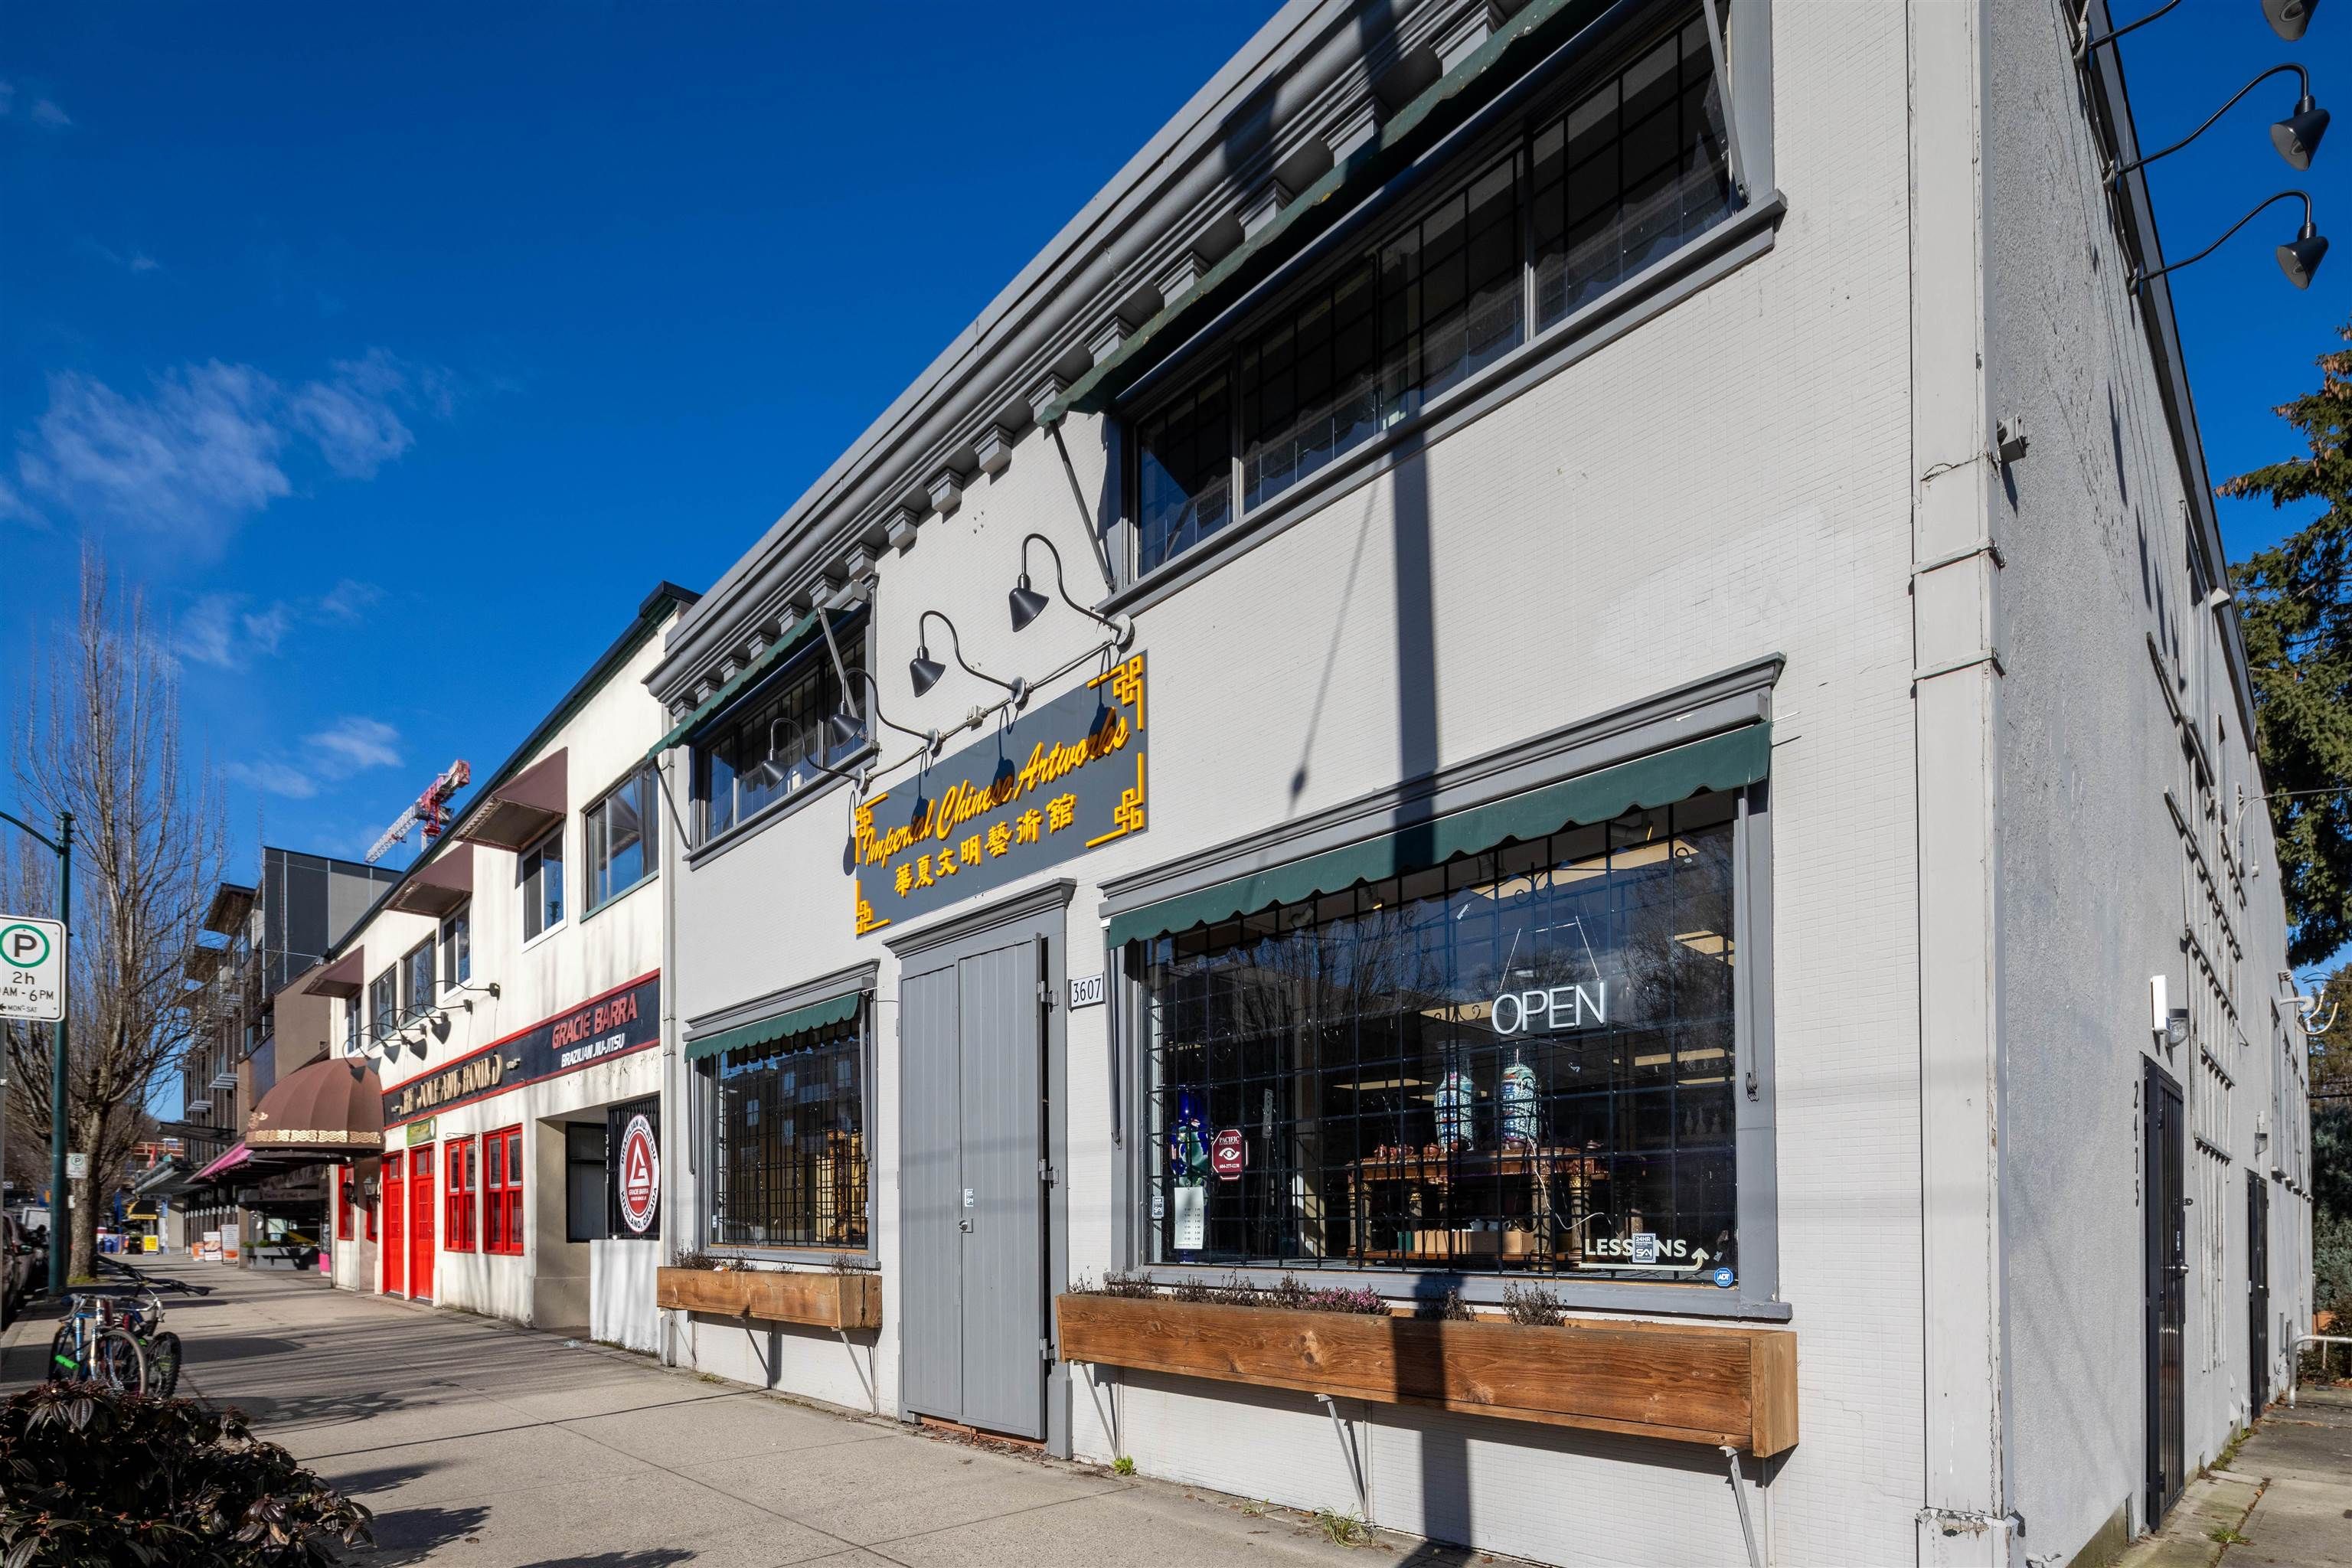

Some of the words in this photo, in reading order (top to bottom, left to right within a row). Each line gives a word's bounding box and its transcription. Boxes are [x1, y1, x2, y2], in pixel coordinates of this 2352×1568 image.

[863, 799, 936, 869] Imperial
[936, 773, 1014, 840] Chinese
[1014, 706, 1131, 799] Artworks
[893, 792, 1077, 898] 華夏文明藝術館
[14, 933, 38, 958] P
[12, 971, 35, 985] 2h
[1073, 978, 1101, 1003] 3607
[552, 1011, 590, 1049] GRACIE
[594, 992, 637, 1034] BARRA
[1491, 982, 1605, 1034] OPEN
[560, 1044, 593, 1068] BRAZILIAN
[593, 1033, 626, 1057] JIU-JITSU
[621, 1119, 639, 1164] BRAZILIAN
[639, 1119, 656, 1160] JIU-JITSU
[643, 1187, 657, 1226] CANADA
[1585, 1239, 1687, 1257] LESSNS
